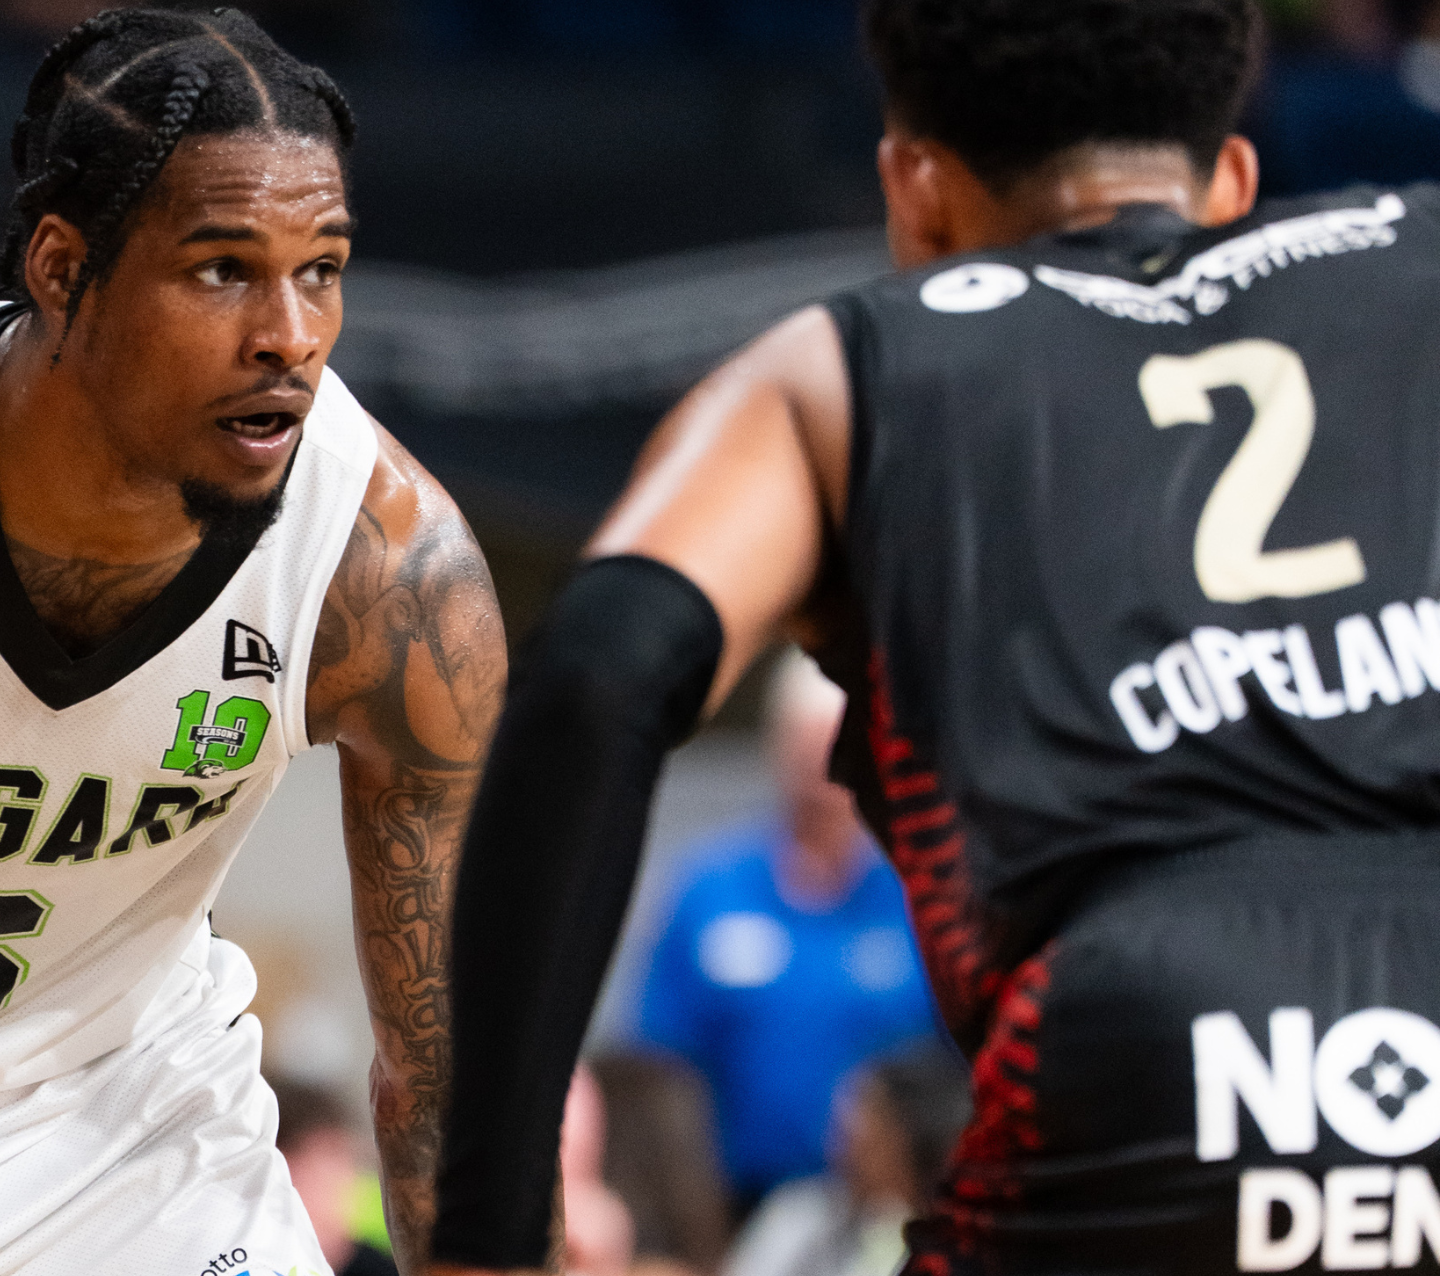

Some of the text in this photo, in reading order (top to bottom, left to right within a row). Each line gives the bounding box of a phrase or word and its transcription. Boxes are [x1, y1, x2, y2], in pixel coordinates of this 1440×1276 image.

[1232, 222, 1398, 291] FITNESS
[1137, 337, 1368, 604] 2
[1108, 597, 1440, 754] COPELAN
[161, 689, 272, 772] 10
[196, 726, 240, 741] SEASONS
